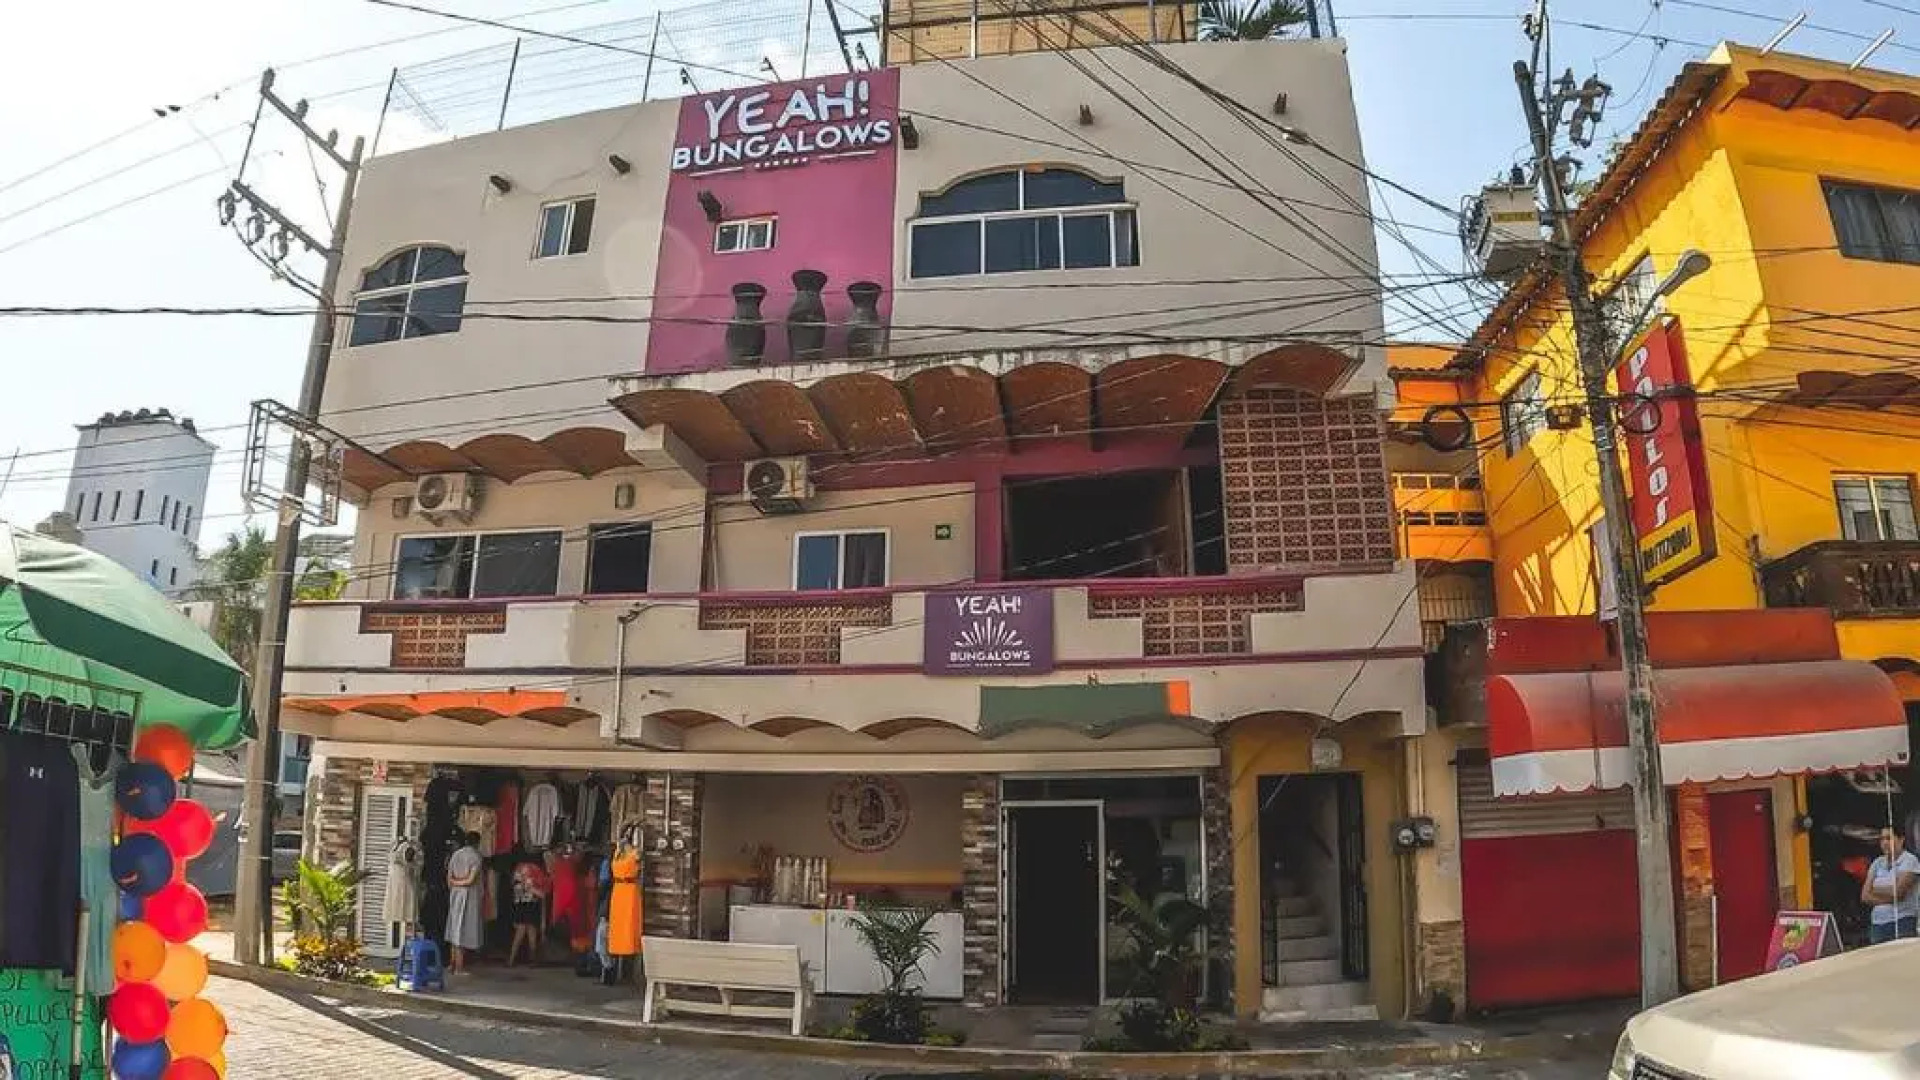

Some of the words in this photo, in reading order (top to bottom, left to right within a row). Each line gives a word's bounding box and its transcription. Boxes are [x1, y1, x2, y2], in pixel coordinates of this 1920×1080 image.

[704, 79, 870, 139] YEAH!
[672, 119, 892, 170] BUNGALOWS
[955, 595, 1021, 616] YEAH!
[950, 650, 1031, 662] BUNGALOWS
